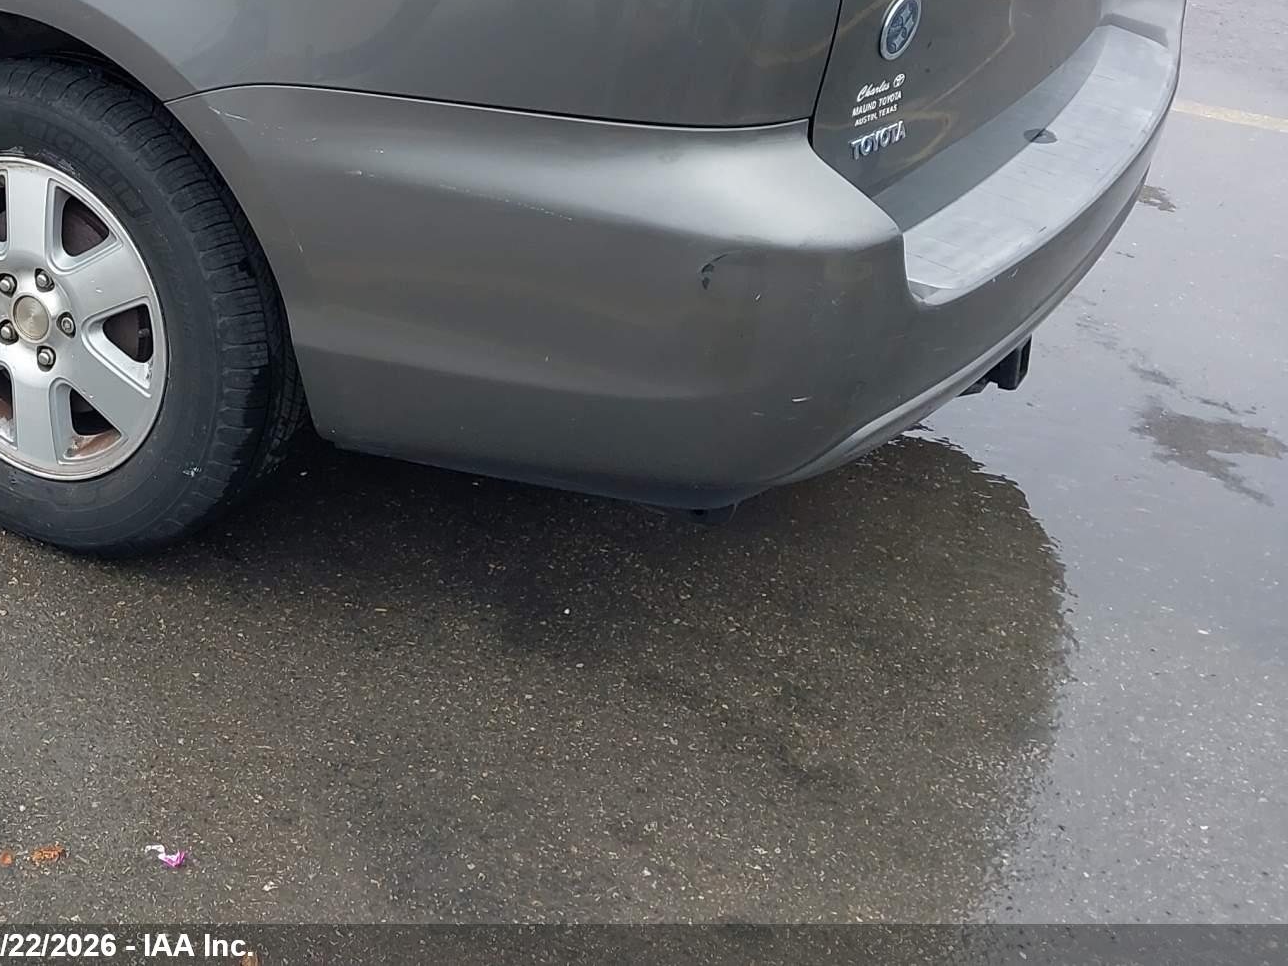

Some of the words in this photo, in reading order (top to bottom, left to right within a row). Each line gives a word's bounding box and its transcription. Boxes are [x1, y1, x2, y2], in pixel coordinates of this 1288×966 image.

[852, 101, 877, 117] MAUND
[879, 91, 902, 107] TOYOTA
[879, 104, 898, 118] TEXAS
[850, 120, 906, 160] TOYOTA
